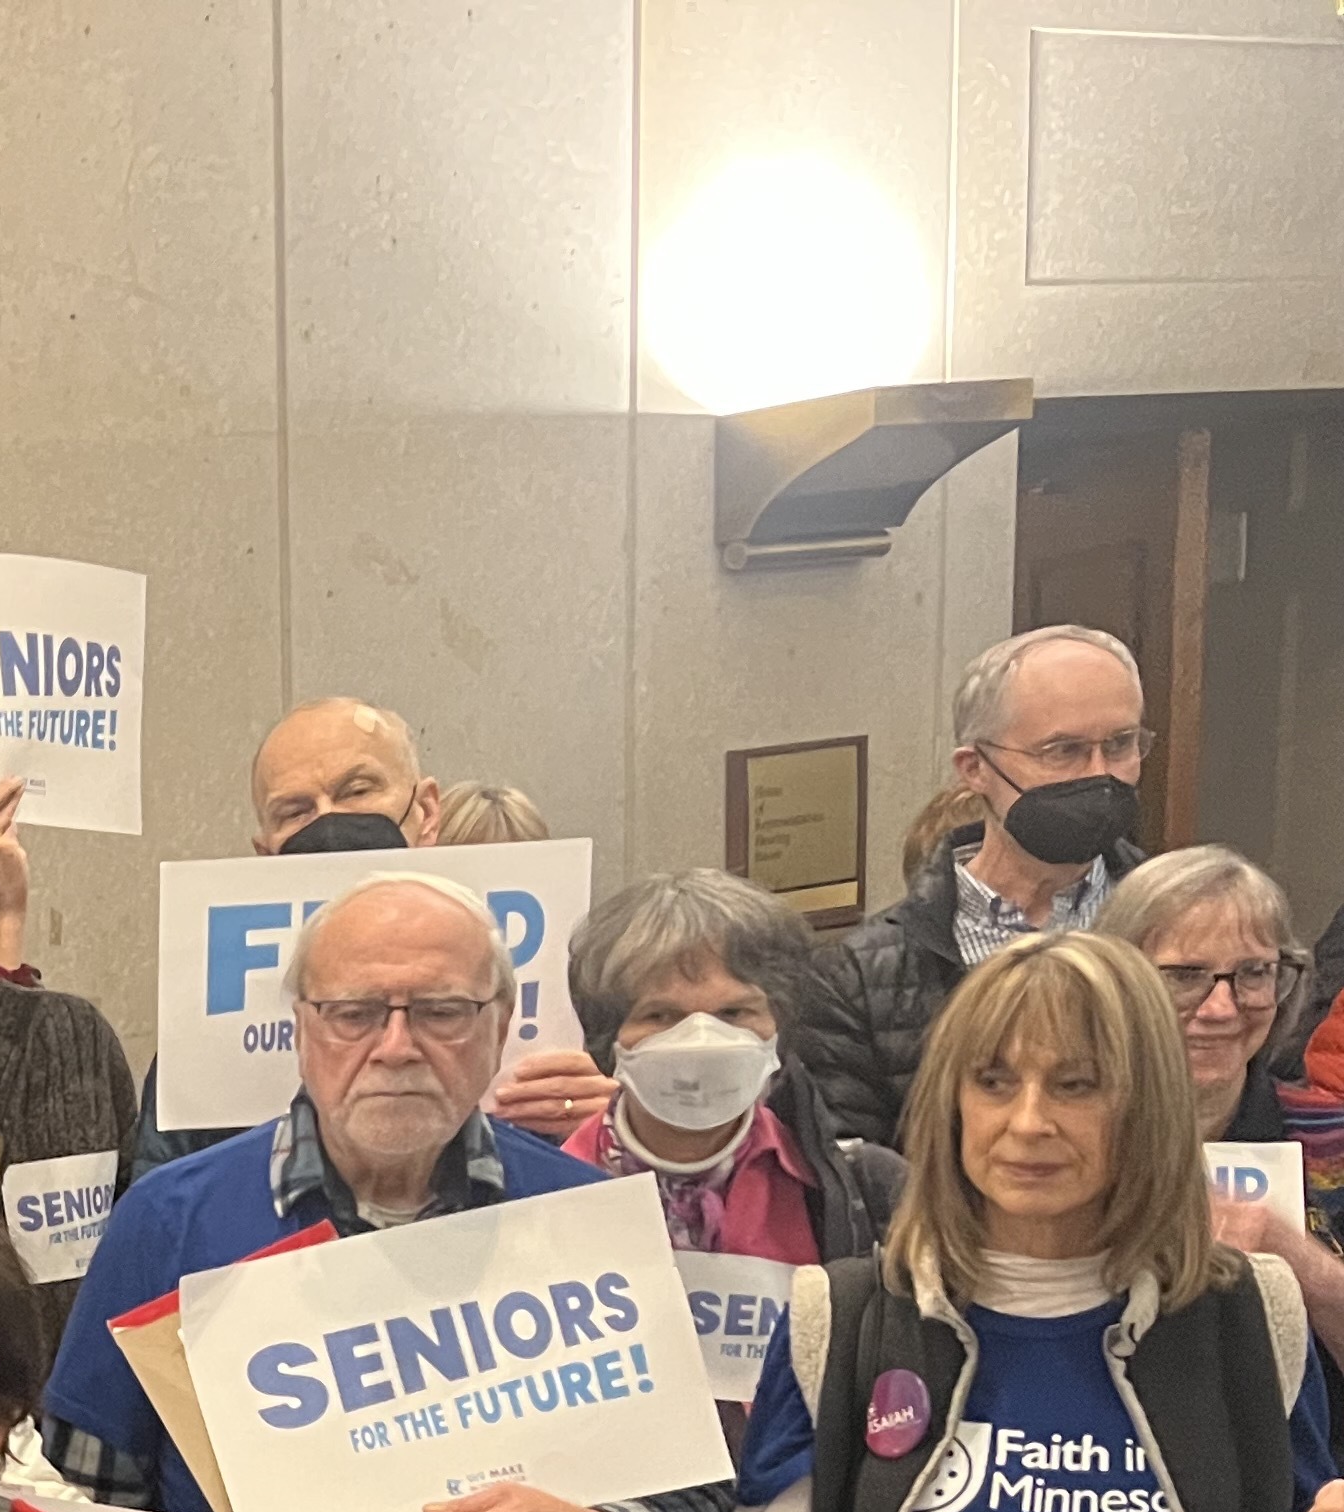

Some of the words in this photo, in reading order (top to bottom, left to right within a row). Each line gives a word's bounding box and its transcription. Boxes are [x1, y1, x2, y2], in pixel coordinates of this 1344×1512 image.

[28, 710, 117, 751] FUTURE!
[206, 890, 545, 1016] FD
[243, 1023, 293, 1053] OUR
[247, 1271, 639, 1429] SENIORS
[746, 1343, 769, 1358] TH
[349, 1422, 392, 1453] FOR
[396, 1406, 448, 1444] THE
[455, 1342, 655, 1432] FUTURE!
[995, 1428, 1109, 1472] Faith
